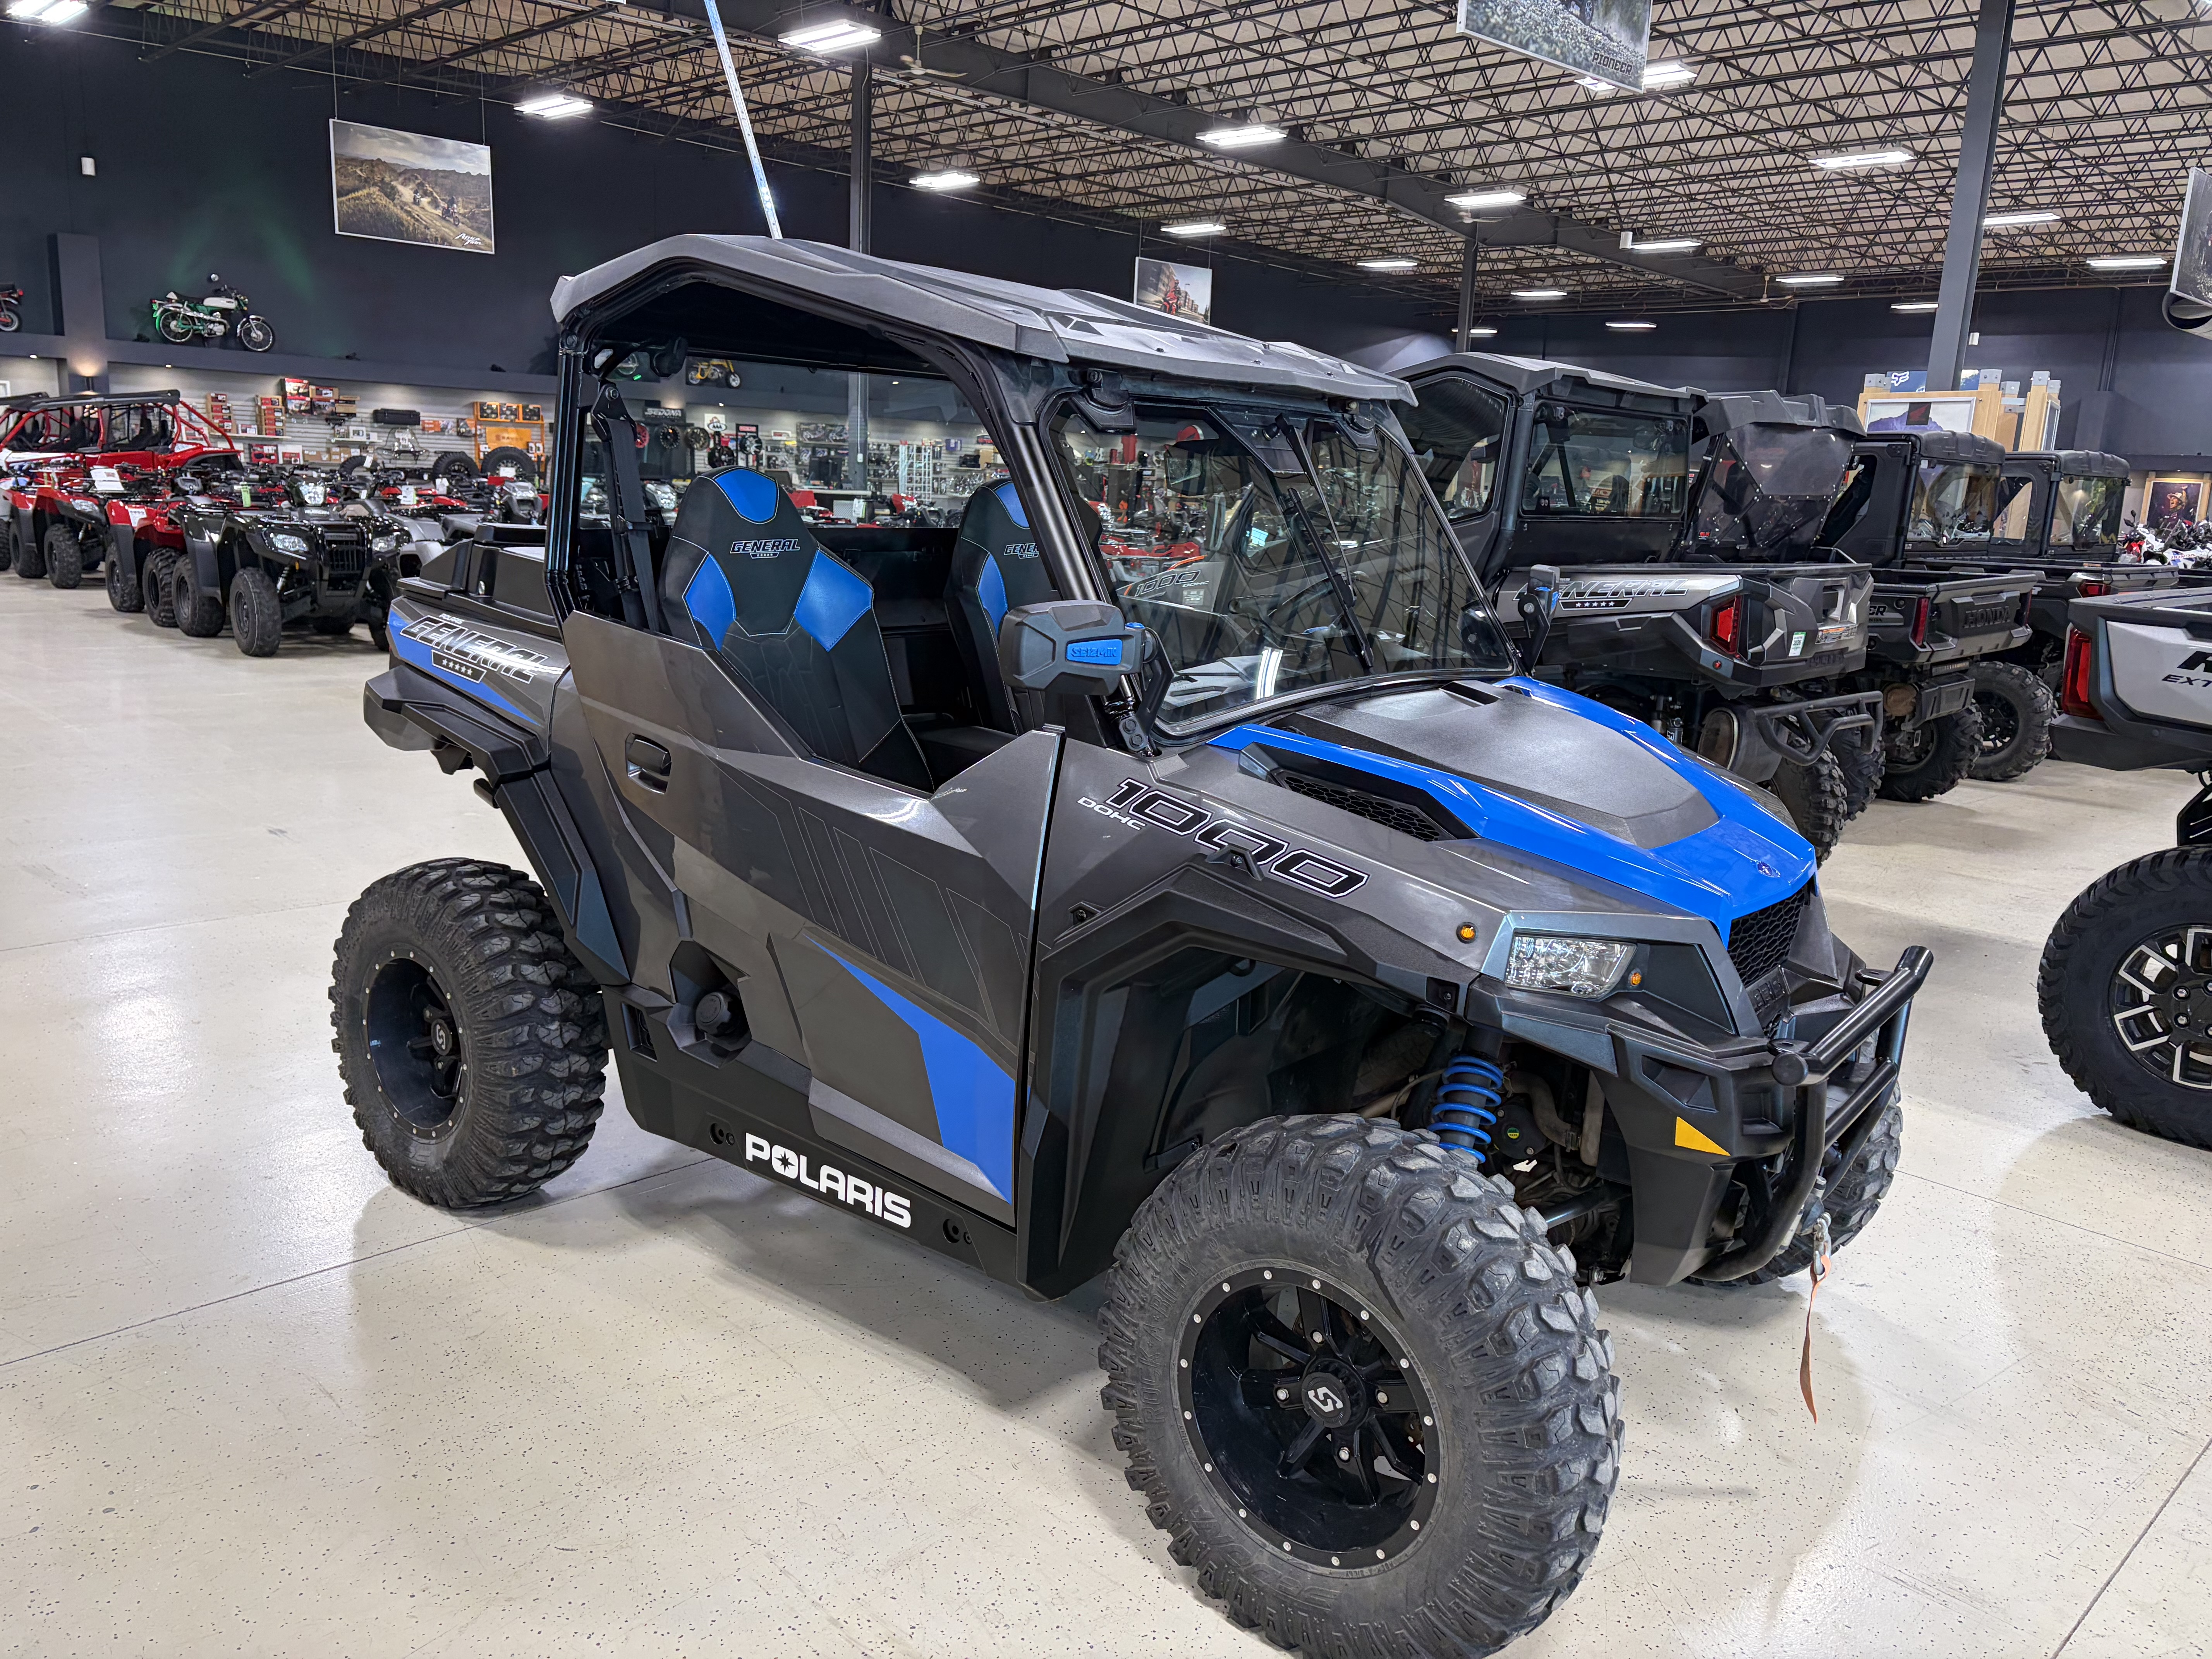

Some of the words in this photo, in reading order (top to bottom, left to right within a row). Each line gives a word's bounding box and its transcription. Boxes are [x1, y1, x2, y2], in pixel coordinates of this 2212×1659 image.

[1592, 52, 1633, 75] PIONEER
[644, 408, 682, 417] SEDONA
[730, 539, 800, 554] GENERAL
[1135, 570, 1201, 597] 1000
[1962, 606, 2011, 628] HONDA
[400, 615, 550, 684] GENERAL
[1077, 797, 1147, 830] DOHC
[1104, 776, 1371, 899] 1000
[745, 1132, 911, 1228] POLARIS
